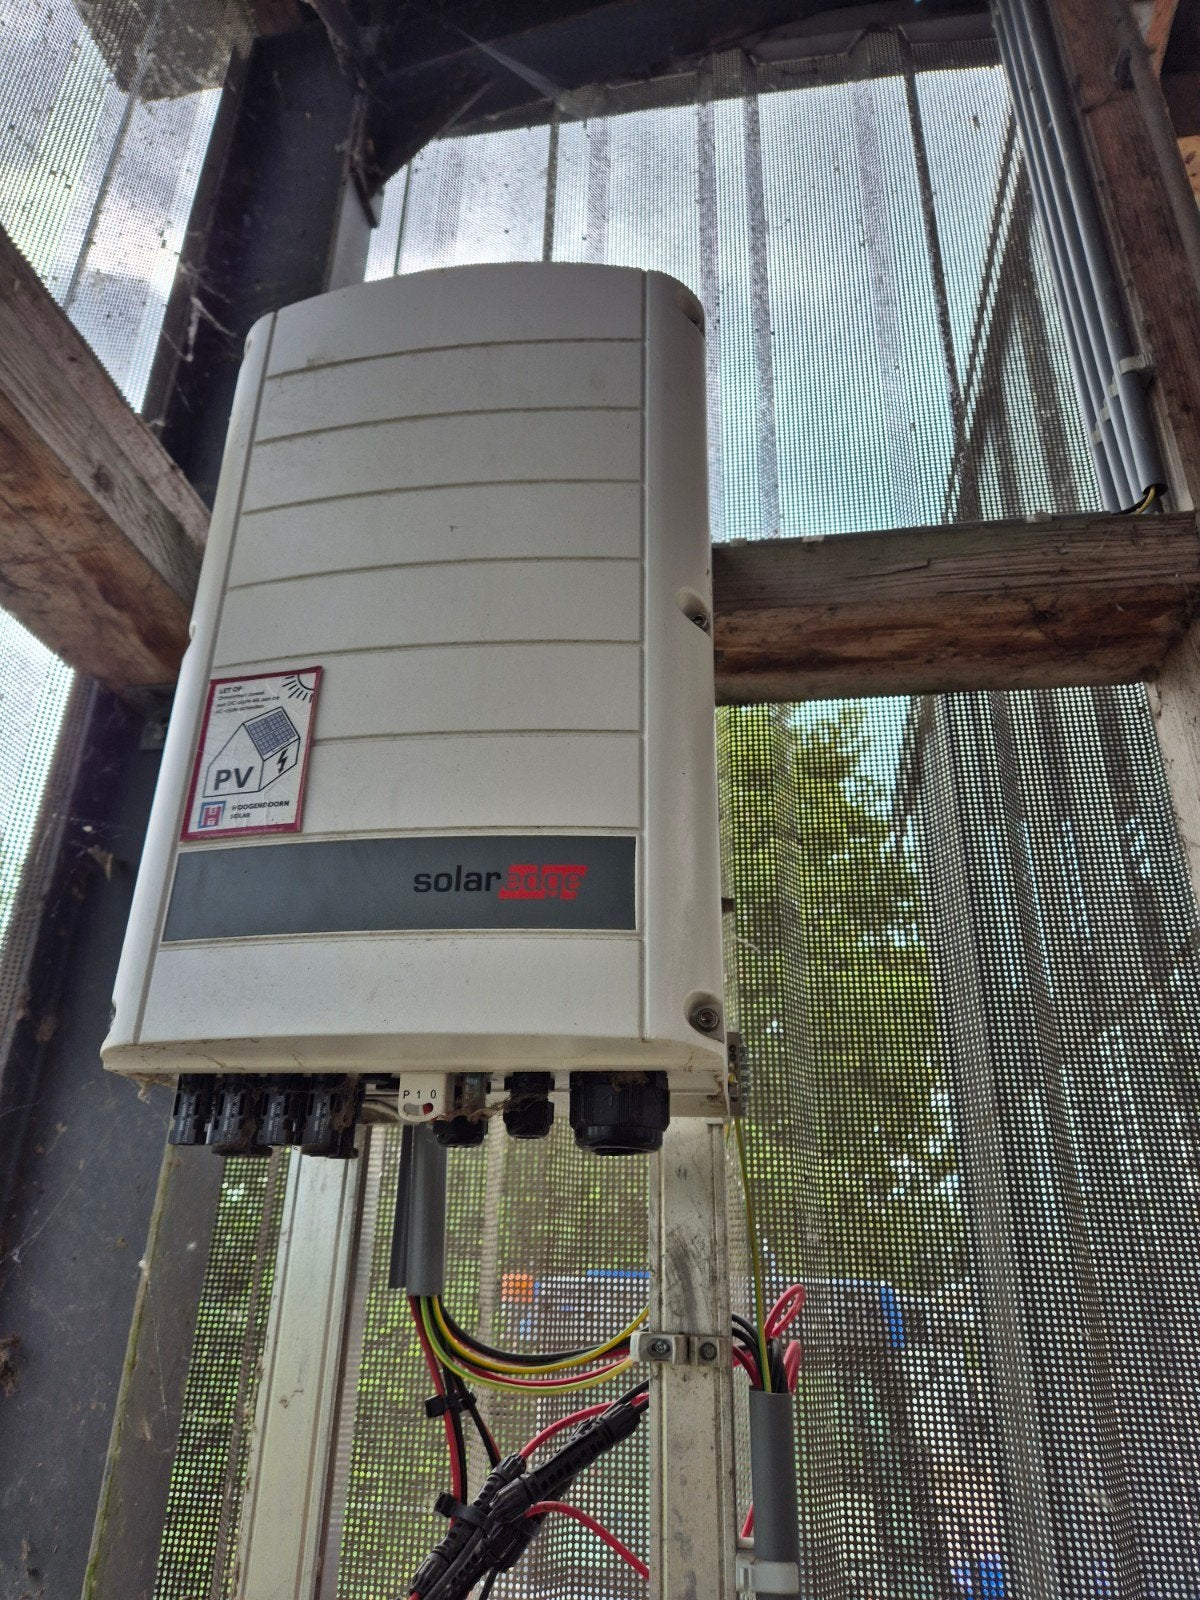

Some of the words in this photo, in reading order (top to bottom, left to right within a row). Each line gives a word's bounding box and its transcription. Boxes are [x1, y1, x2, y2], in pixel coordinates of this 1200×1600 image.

[213, 766, 254, 791] PV
[232, 800, 290, 811] HOOGENDOORN
[403, 1090, 410, 1099] P
[417, 1090, 421, 1099] 1
[430, 1089, 437, 1099] 0
